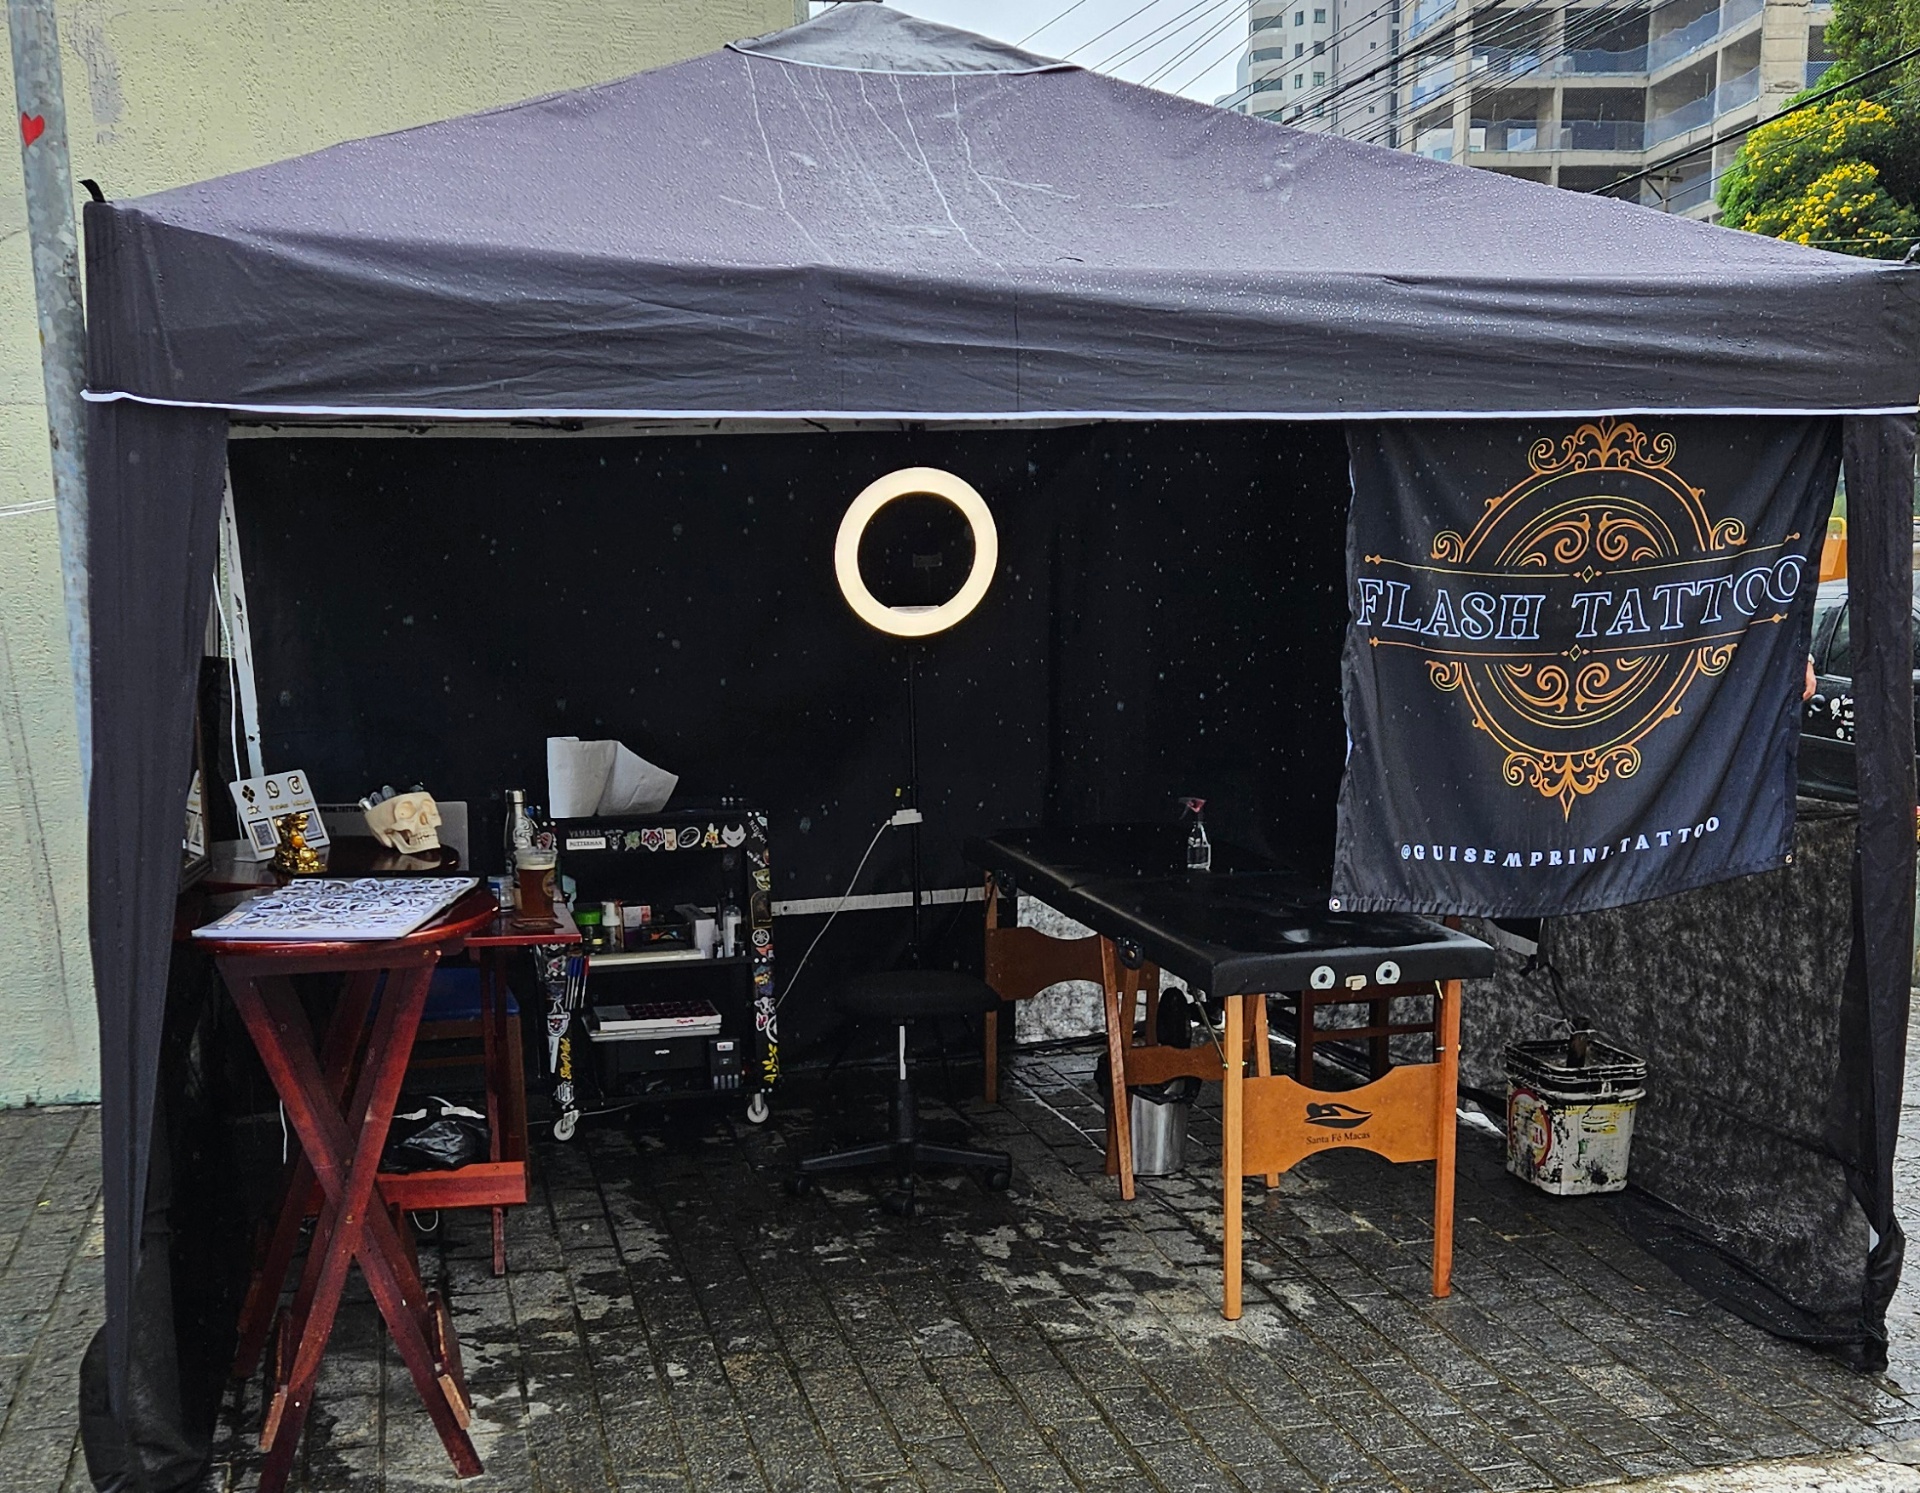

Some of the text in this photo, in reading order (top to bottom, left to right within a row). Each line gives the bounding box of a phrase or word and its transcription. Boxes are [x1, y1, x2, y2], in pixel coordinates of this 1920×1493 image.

[1356, 554, 1808, 641] FLASH TATTOO
[1400, 815, 1721, 868] @GUISEMPRINI.TATTOO
[1306, 1135, 1329, 1146] Santa
[1344, 1131, 1371, 1141] Macas
